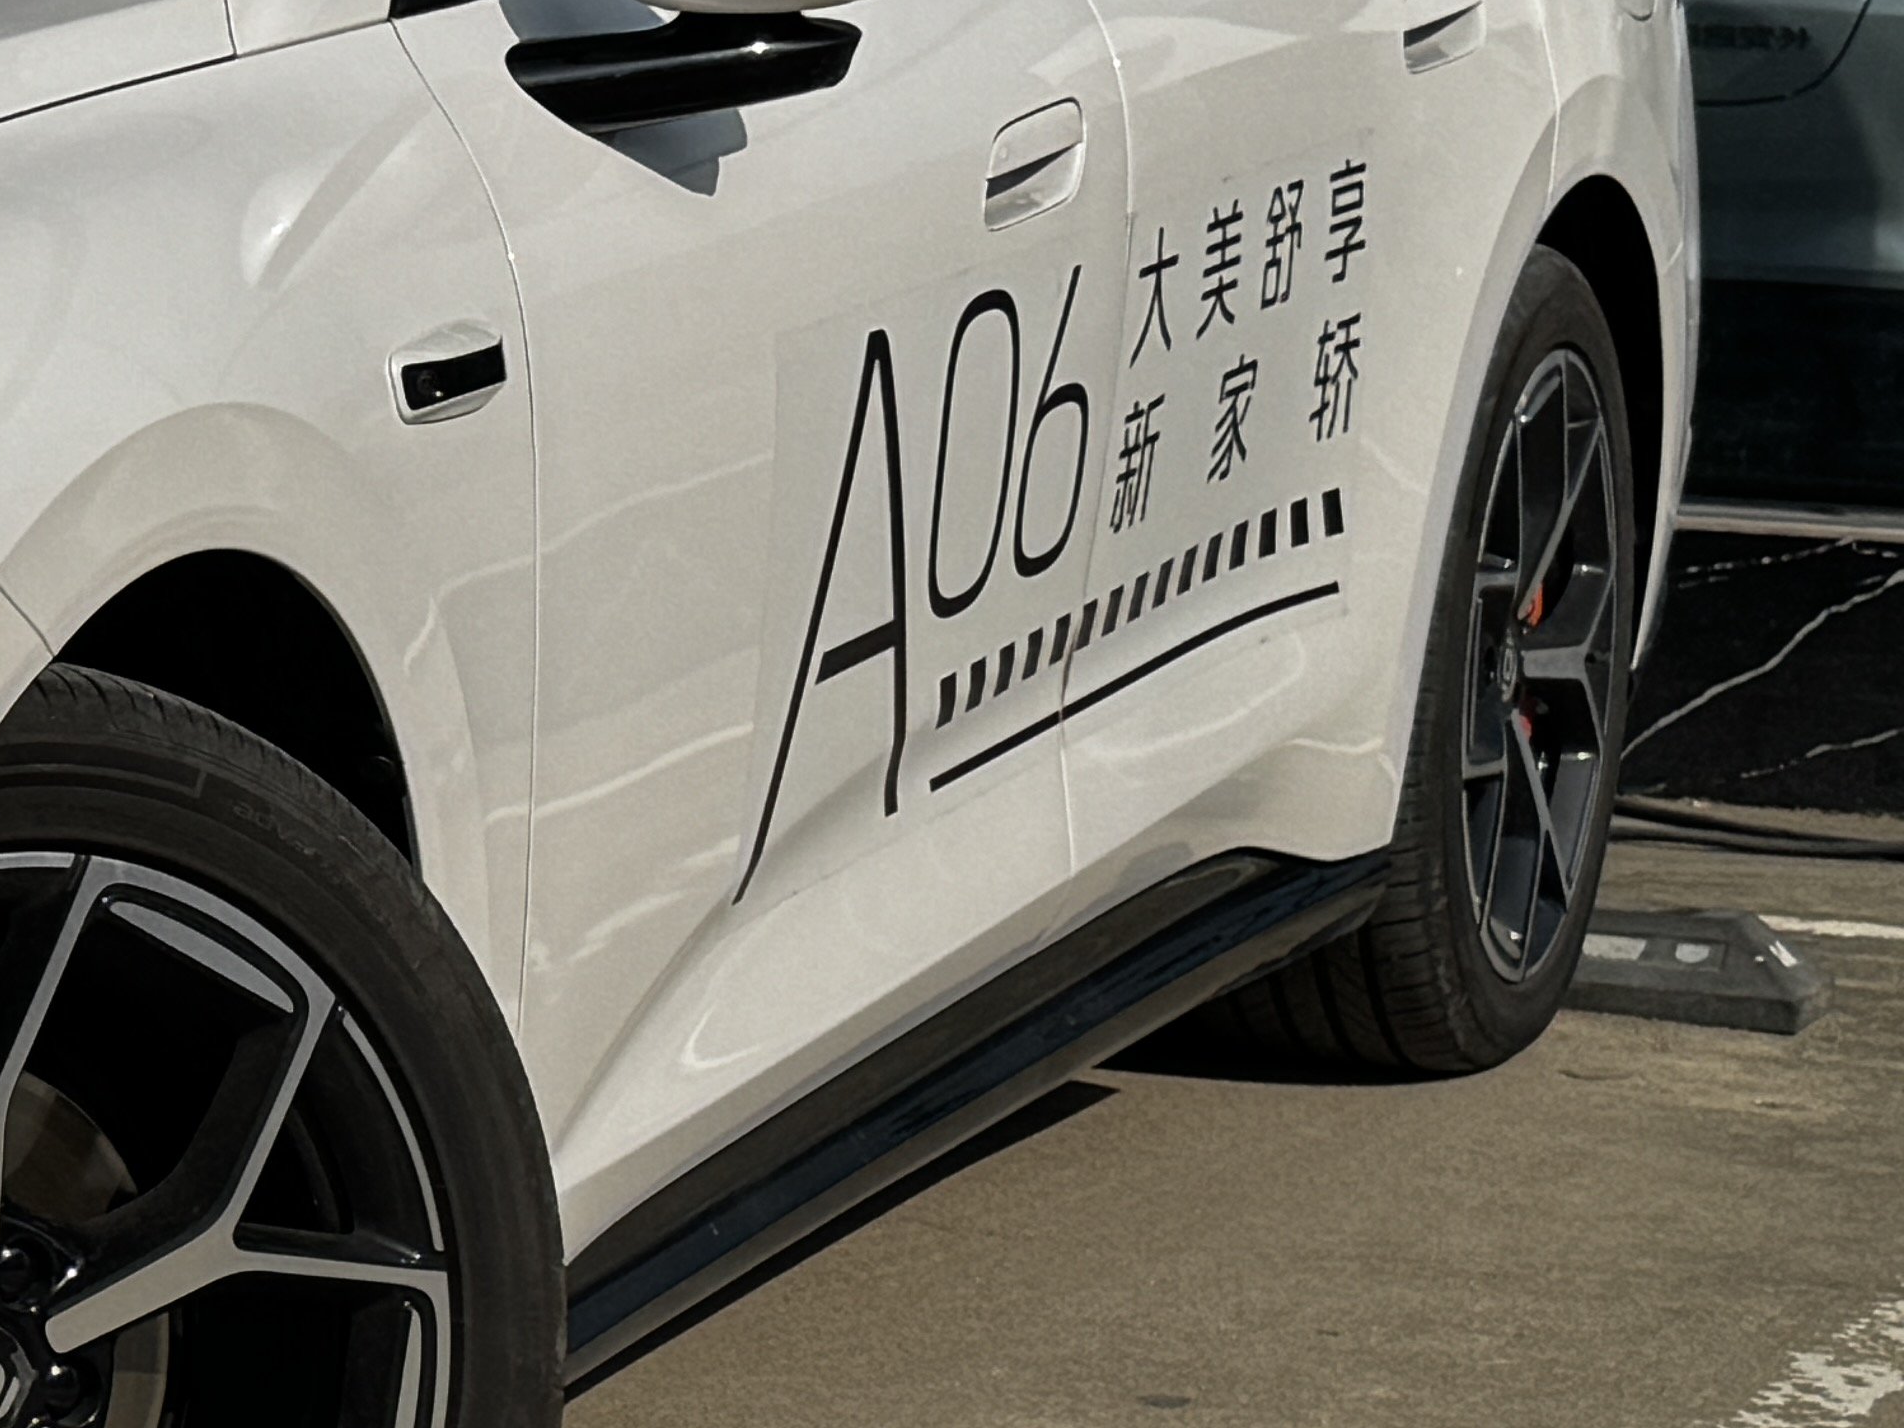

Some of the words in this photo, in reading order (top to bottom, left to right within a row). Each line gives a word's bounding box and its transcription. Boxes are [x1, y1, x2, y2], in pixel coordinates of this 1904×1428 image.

[1130, 158, 1367, 368] 大美舒享
[1109, 312, 1362, 534] 新家轿
[731, 263, 1092, 907] A06
